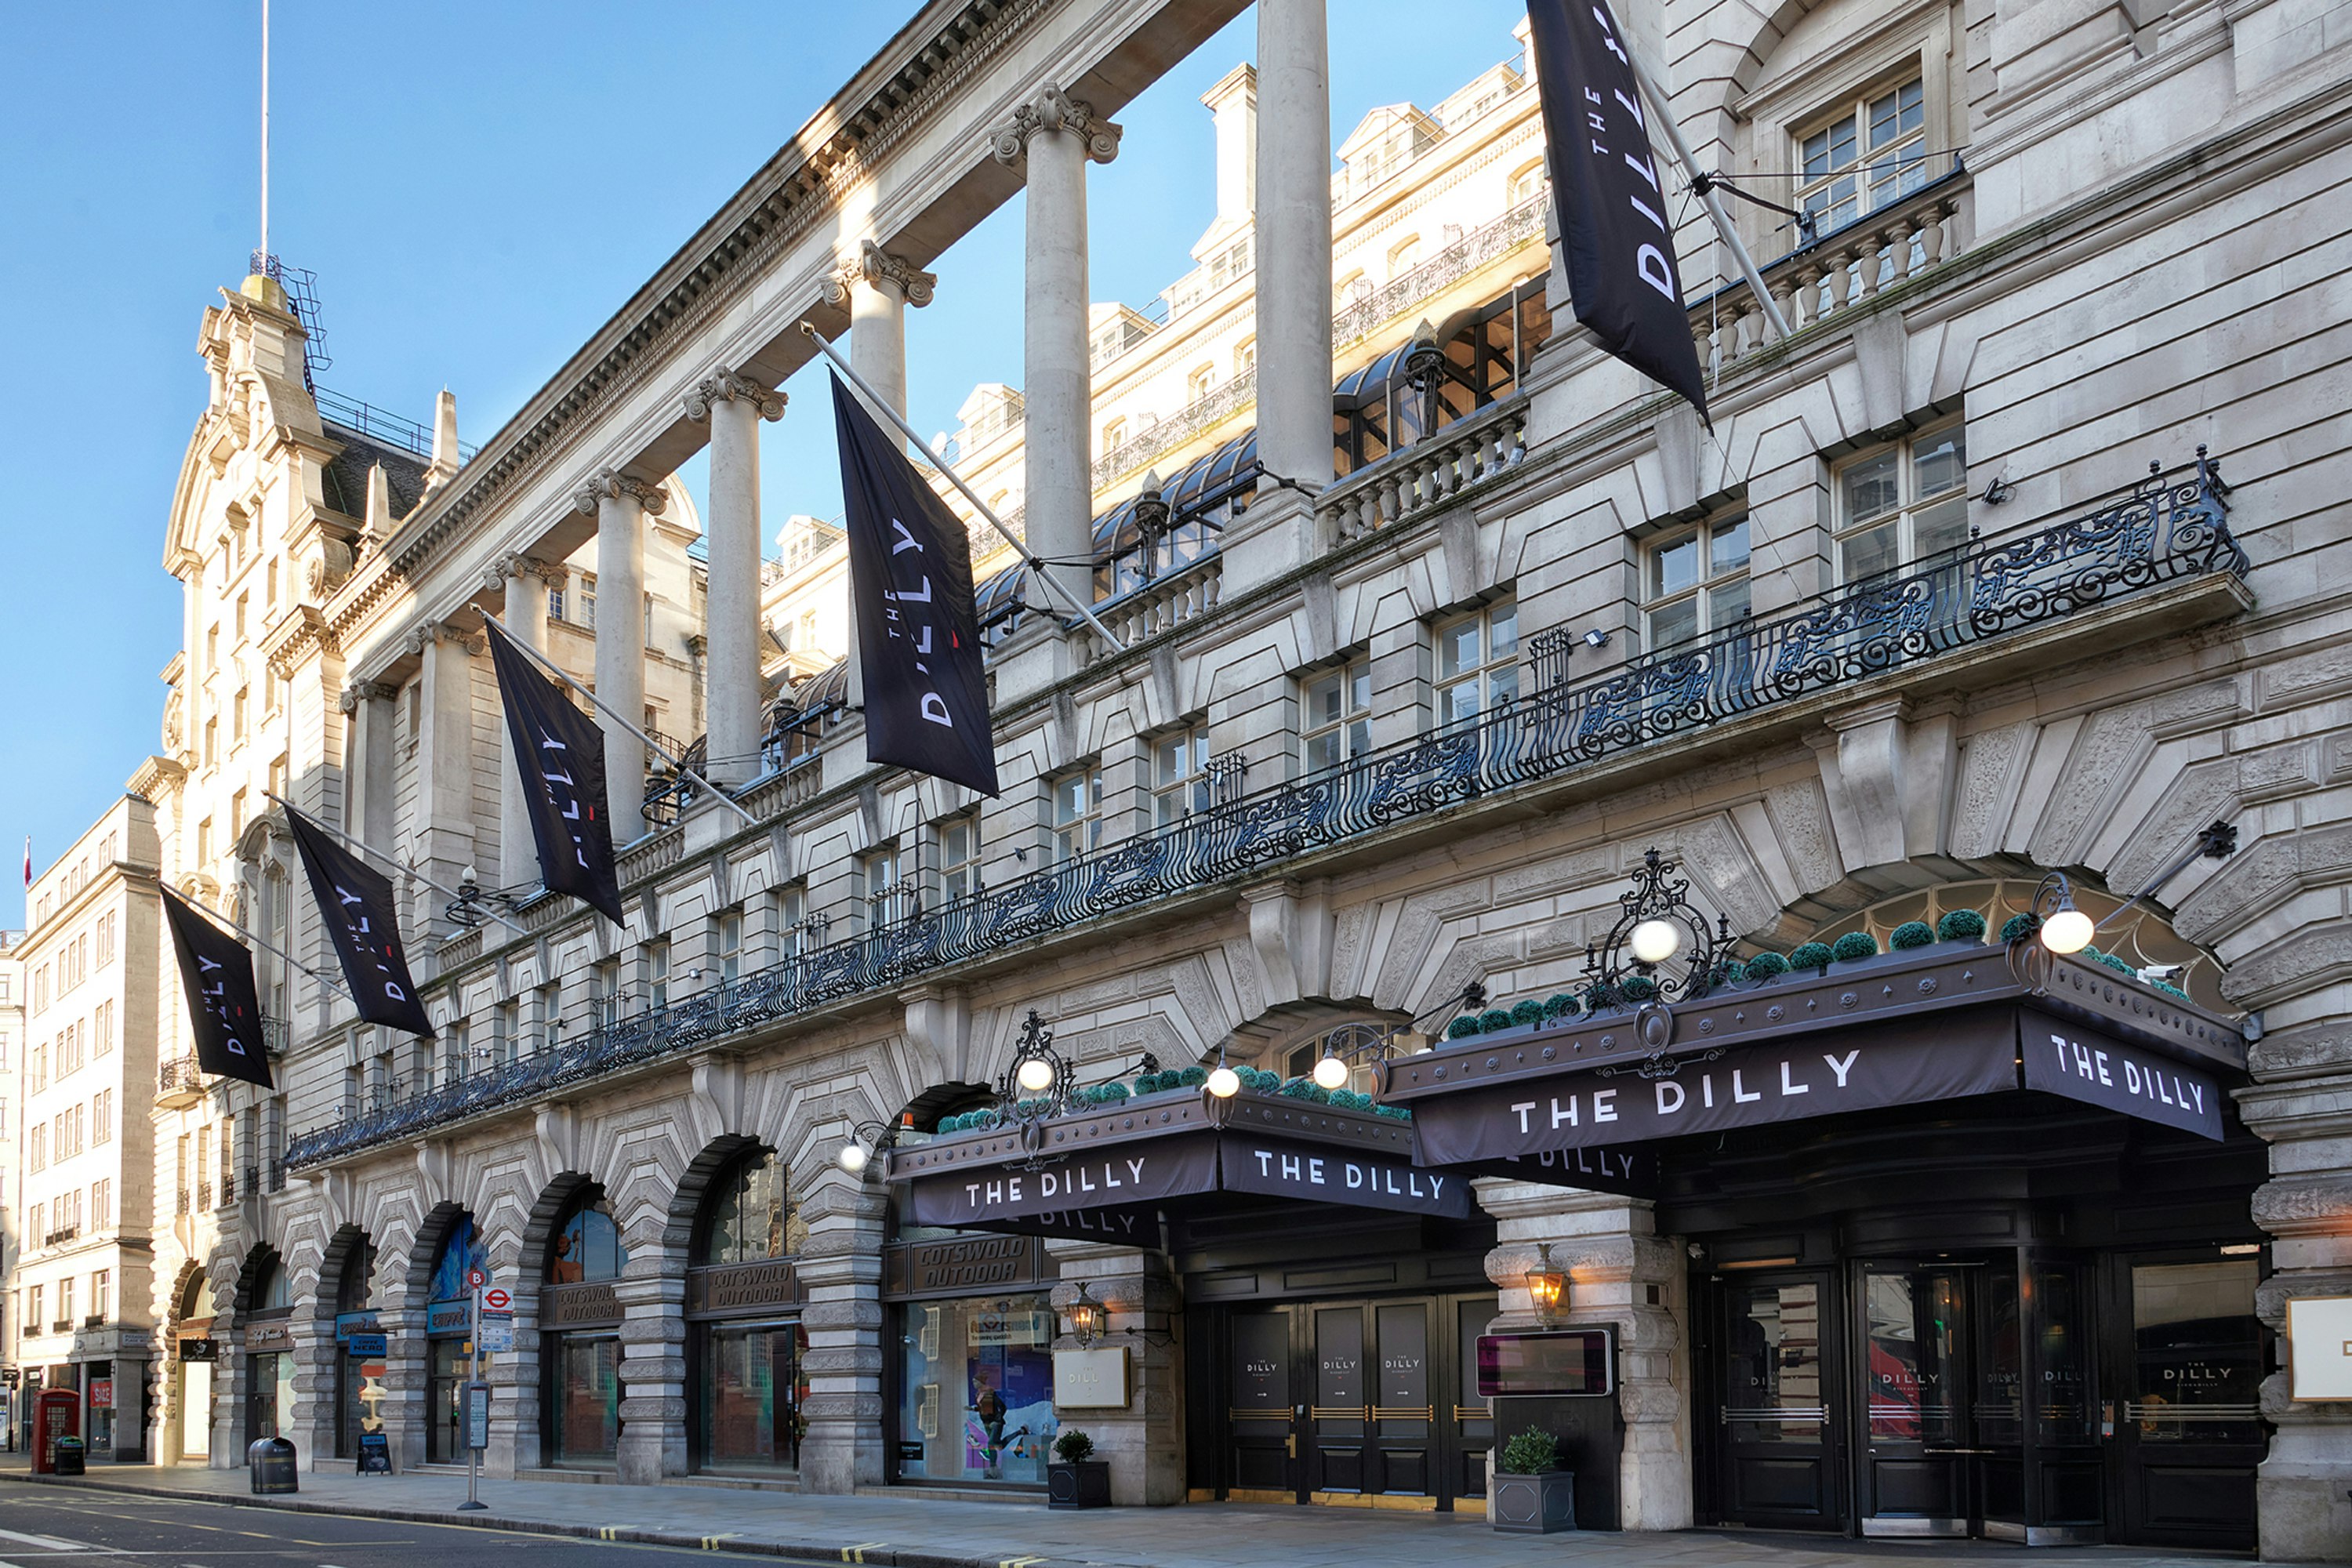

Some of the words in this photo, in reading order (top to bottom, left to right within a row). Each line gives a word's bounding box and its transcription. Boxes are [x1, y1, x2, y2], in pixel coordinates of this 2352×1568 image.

[1584, 86, 1609, 155] THE
[1592, 5, 1675, 303] DILLY
[884, 589, 901, 639] THE
[892, 517, 953, 728] DILLY
[335, 884, 407, 1002] DILY
[347, 924, 365, 952] THE
[201, 989, 214, 1013] THE
[2051, 1034, 2113, 1087] THE
[2124, 1060, 2203, 1115] DILLY
[1511, 1088, 1619, 1134] THE
[1655, 1049, 1860, 1115] DILLY
[1254, 1150, 1325, 1185] THE
[1345, 1163, 1444, 1200] DILLY
[1539, 1147, 1633, 1179] DILLY
[965, 1177, 1022, 1207] THE
[1041, 1157, 1145, 1197] DILLY
[1039, 1210, 1134, 1234] DILLY
[919, 1237, 1025, 1267] COTSWOLD
[473, 1272, 482, 1284] B
[714, 1266, 790, 1288] COTSWOLD
[925, 1261, 1017, 1287] OUTDOOR
[560, 1286, 616, 1305] COTSWOL
[719, 1286, 784, 1306] OUTDOOR
[564, 1303, 615, 1321] OUTDOOR
[1385, 1359, 1419, 1368] DILLY
[2164, 1368, 2231, 1380] DILLY
[1882, 1374, 1939, 1384] DILLY
